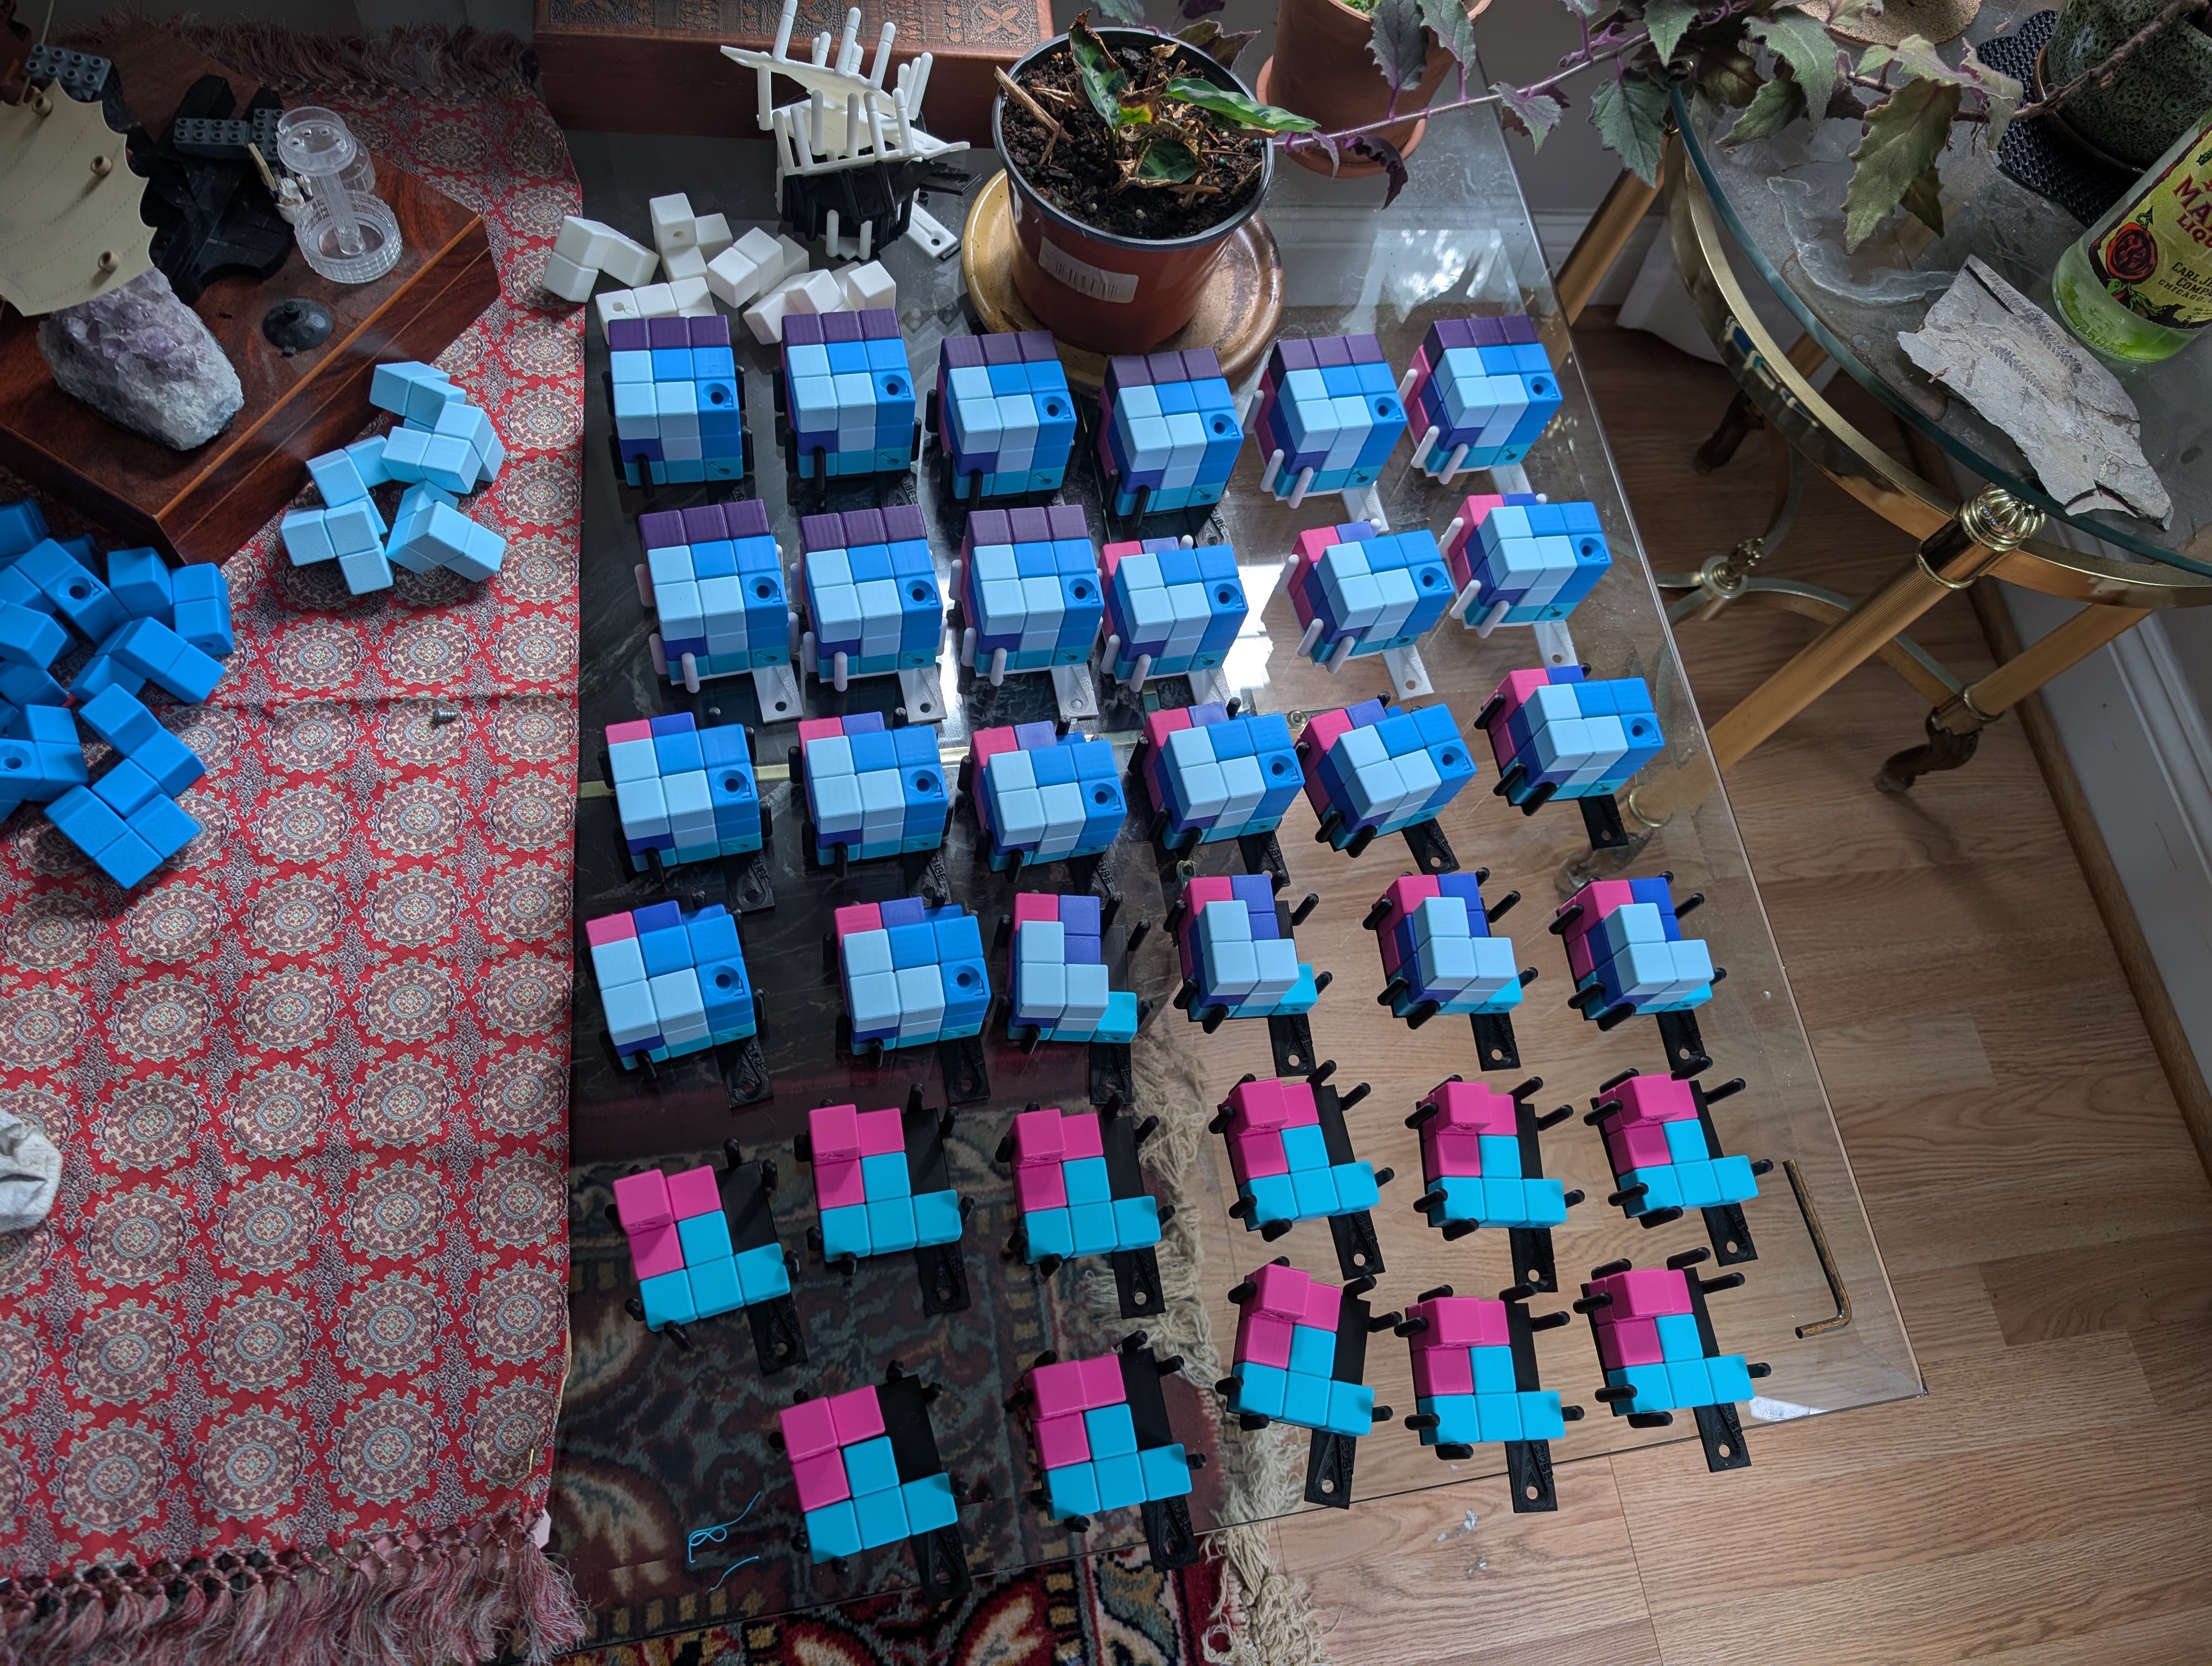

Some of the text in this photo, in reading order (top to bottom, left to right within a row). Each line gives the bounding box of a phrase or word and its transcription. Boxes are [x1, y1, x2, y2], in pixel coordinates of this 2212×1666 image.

[2171, 262, 2200, 282] CARL
[779, 669, 798, 693] CUBE
[924, 671, 940, 696] CUBE
[1076, 669, 1094, 693] CUBE
